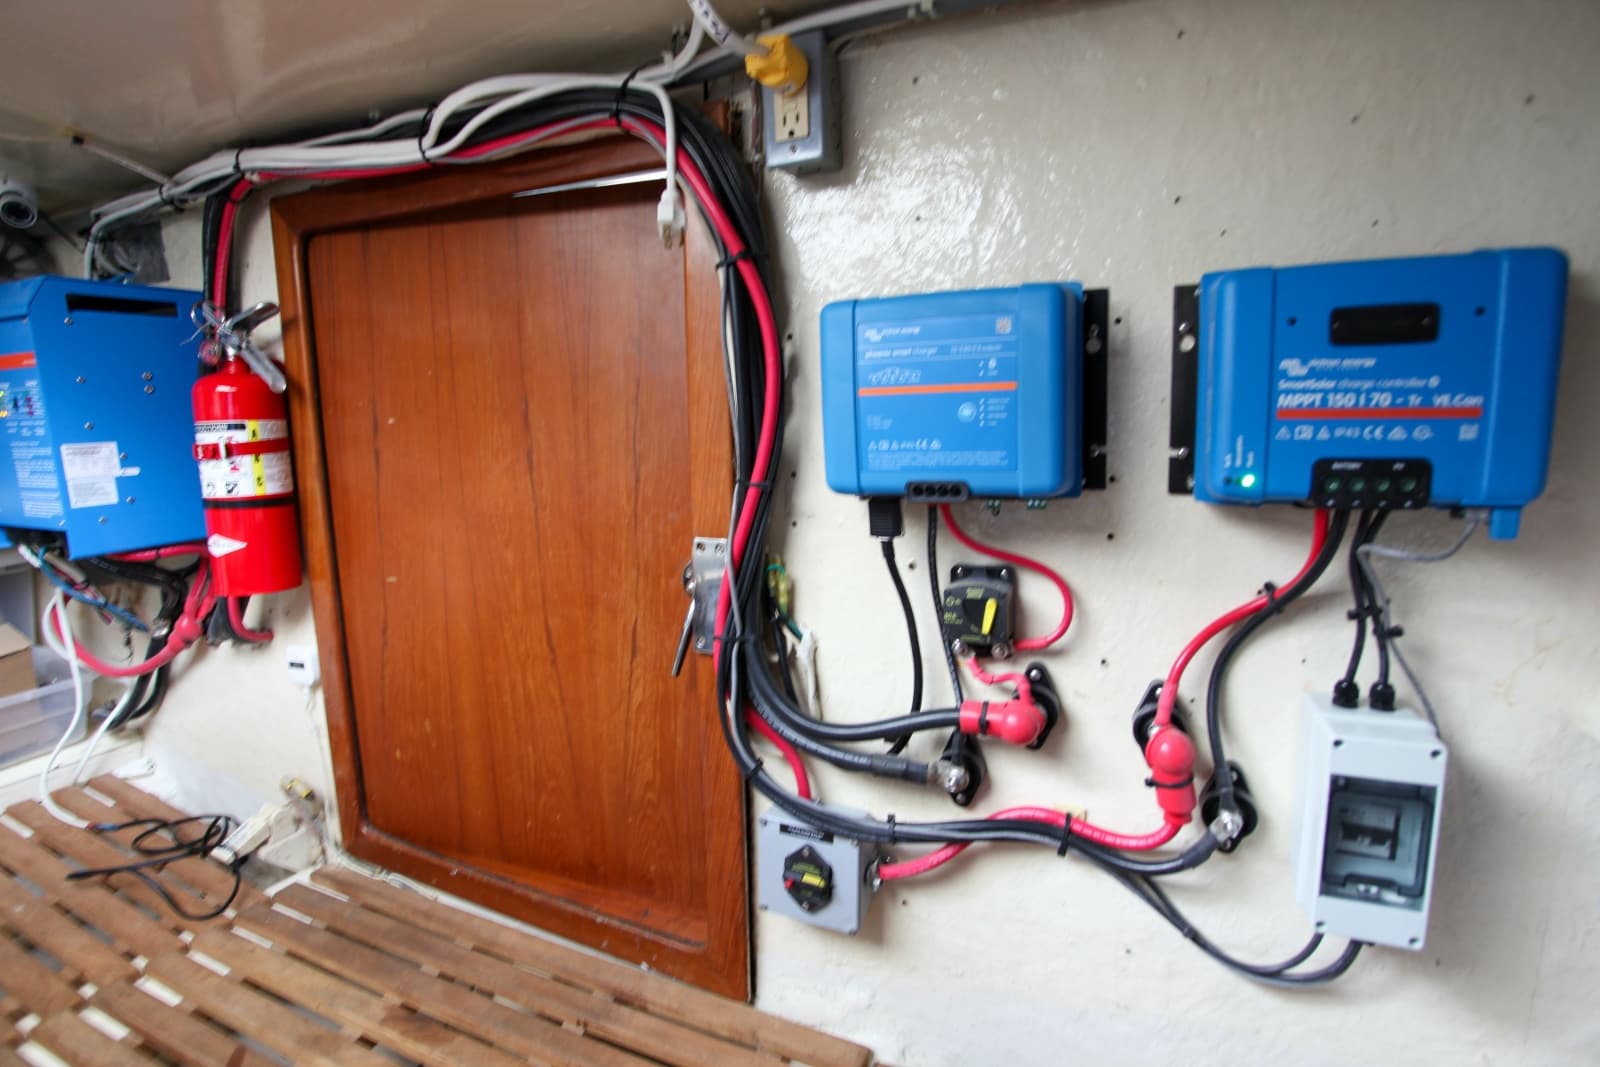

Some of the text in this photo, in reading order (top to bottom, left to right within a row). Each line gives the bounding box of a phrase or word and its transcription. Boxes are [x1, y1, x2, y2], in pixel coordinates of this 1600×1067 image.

[1276, 392, 1323, 408] MPPT
[1327, 392, 1356, 408] 150
[1368, 391, 1393, 408] 70
